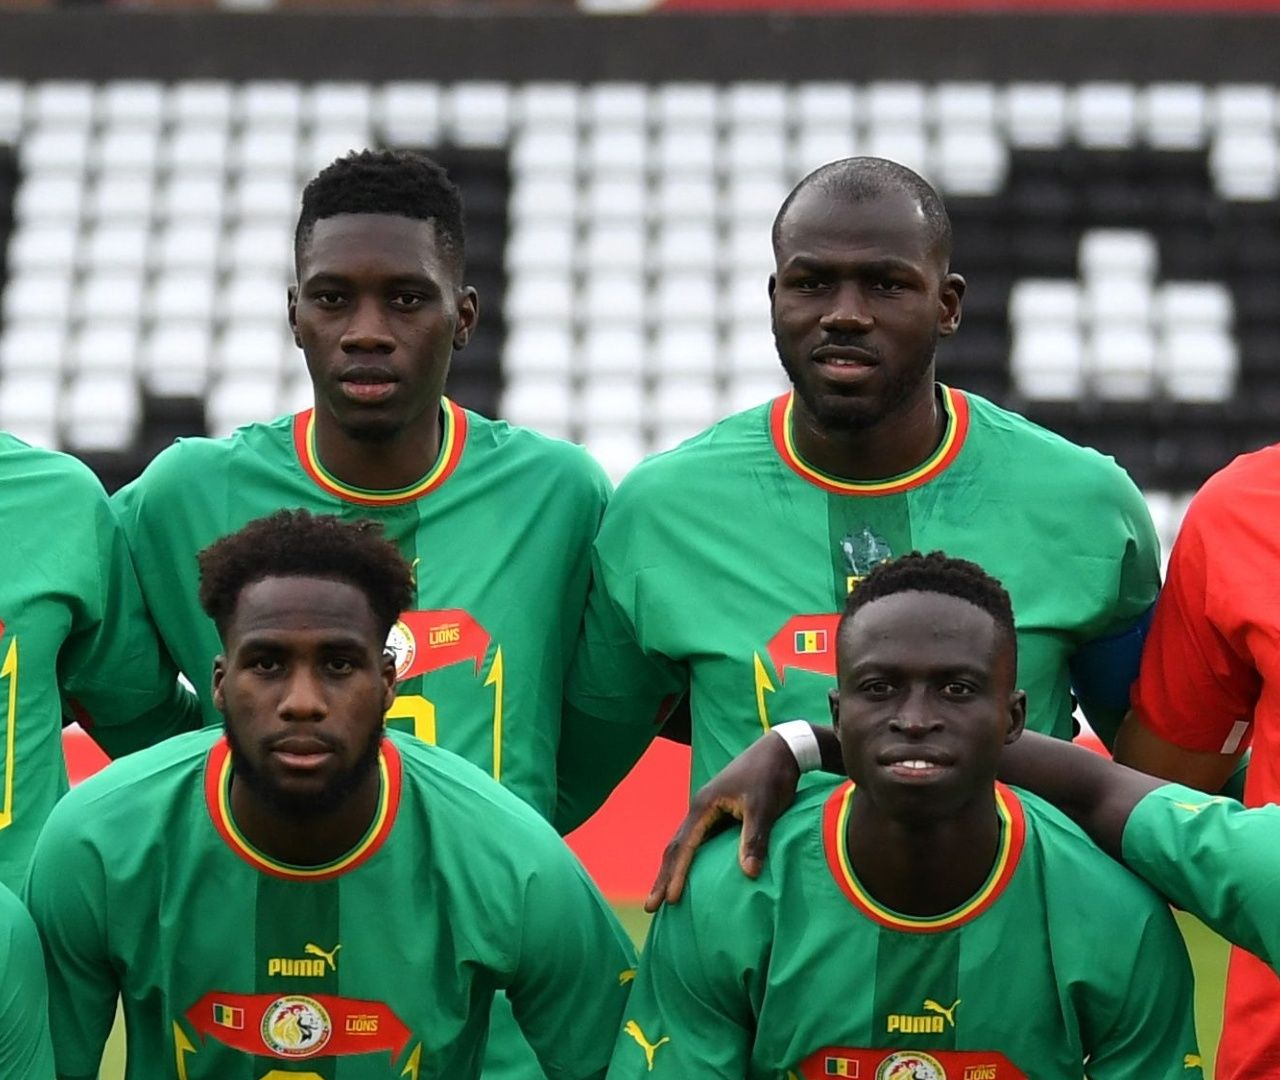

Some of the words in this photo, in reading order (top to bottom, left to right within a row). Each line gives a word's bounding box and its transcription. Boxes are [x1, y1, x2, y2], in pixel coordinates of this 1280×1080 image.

[429, 628, 460, 645] LIONS
[268, 958, 325, 976] PUMA
[346, 1019, 378, 1032] LIONS
[887, 1015, 944, 1033] PUMA
